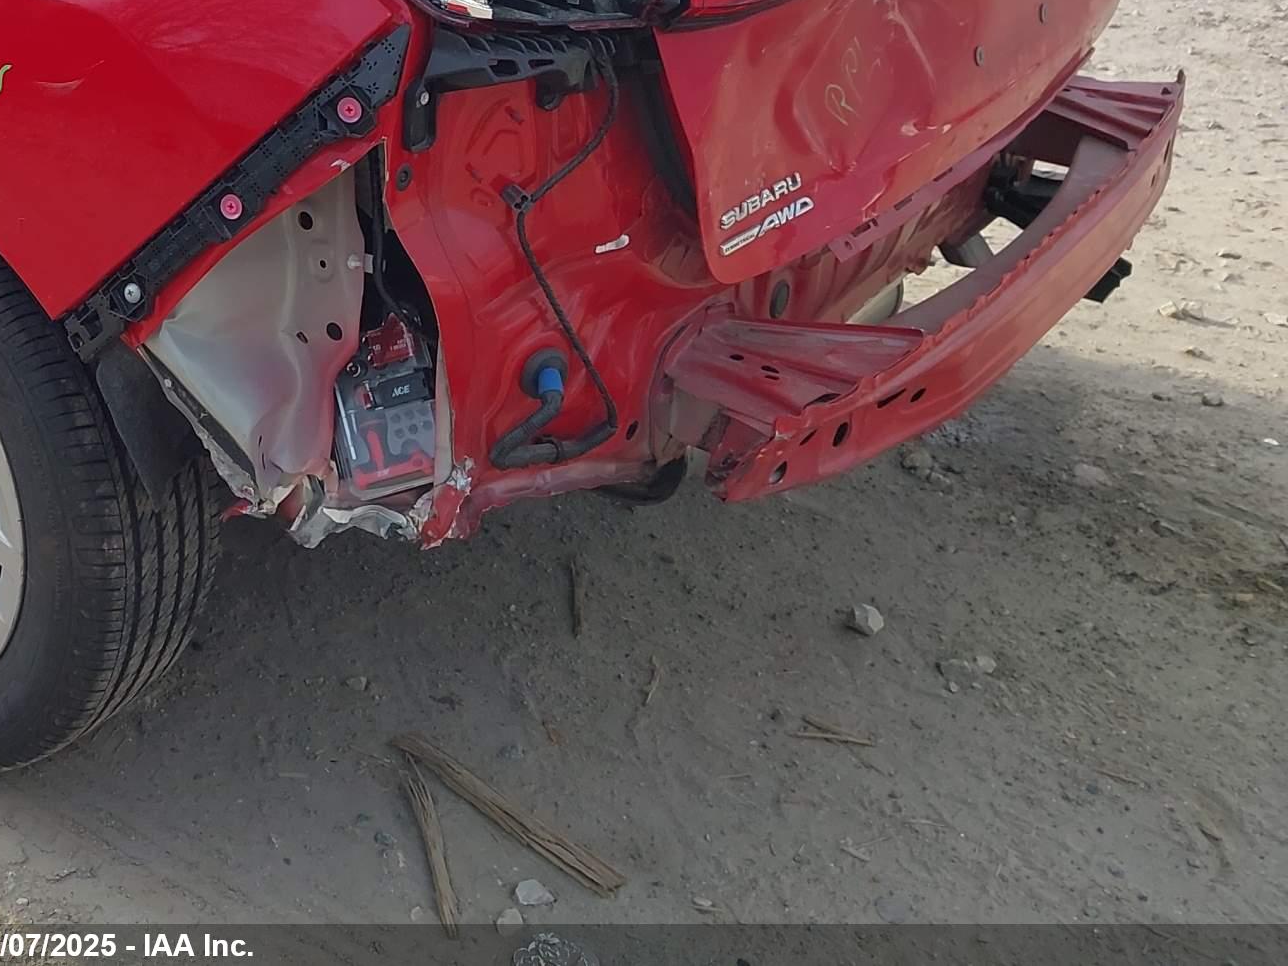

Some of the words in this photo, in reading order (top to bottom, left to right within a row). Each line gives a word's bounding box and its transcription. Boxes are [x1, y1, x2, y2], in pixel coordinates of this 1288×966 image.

[720, 171, 803, 230] SUBARU
[757, 196, 815, 238] AWD
[392, 384, 410, 398] ACE
